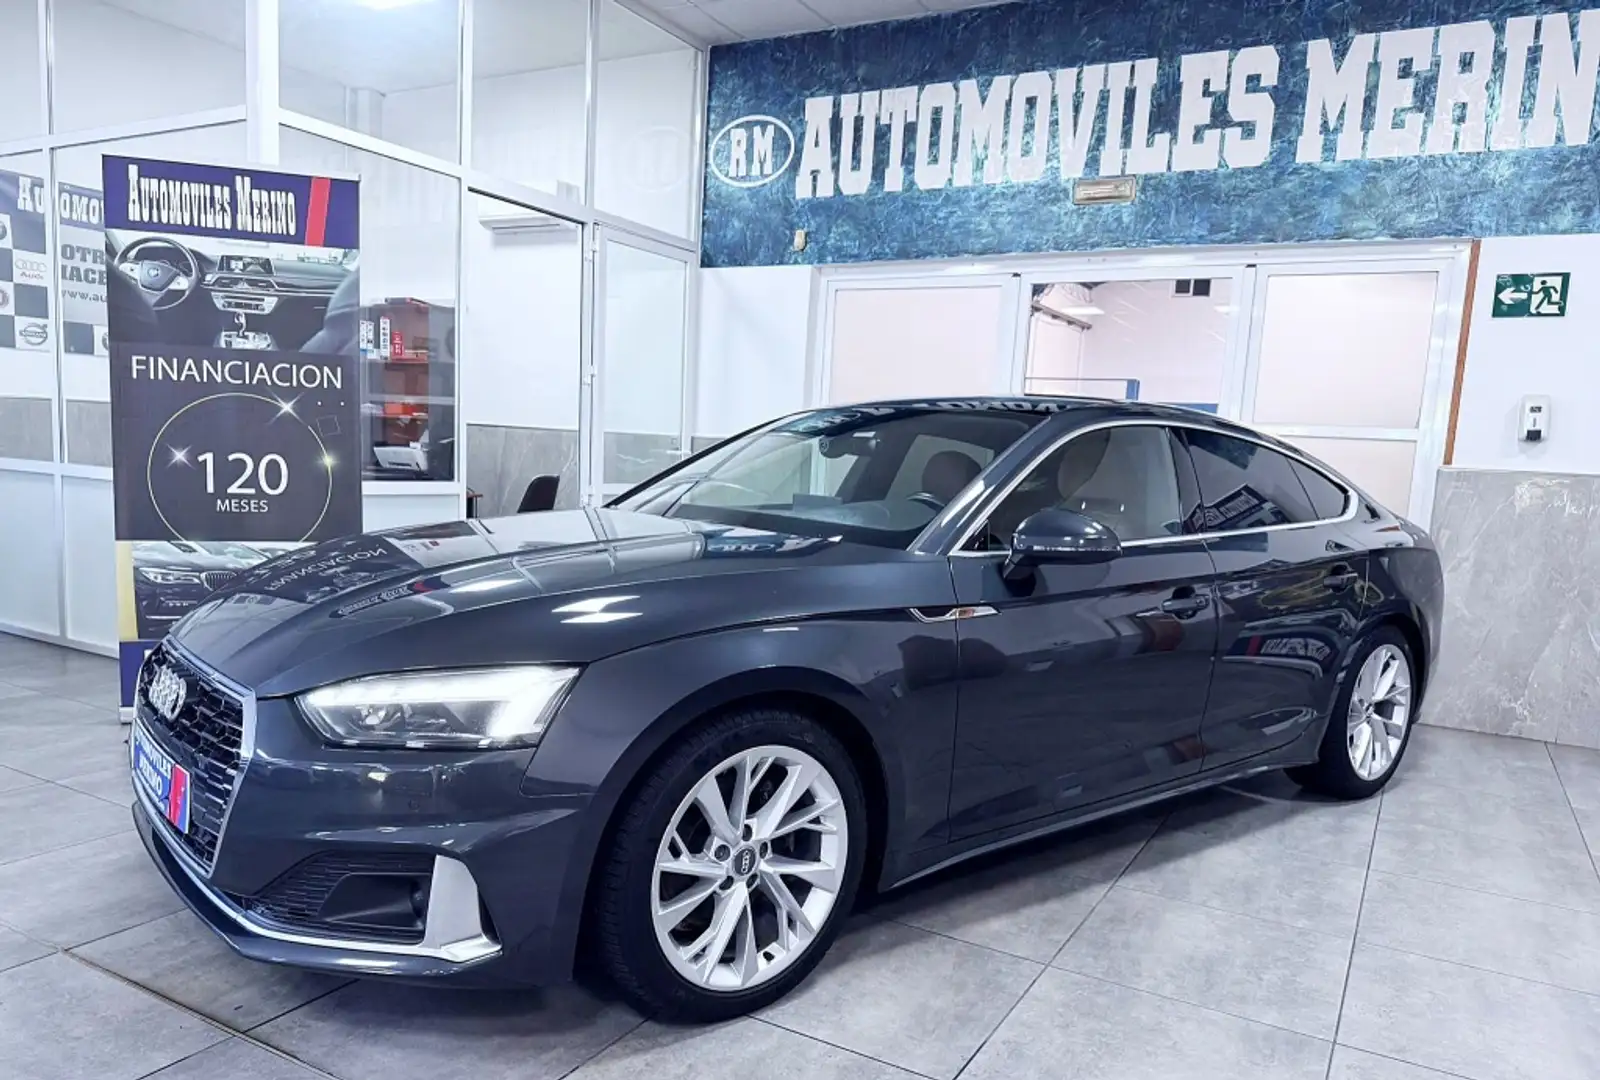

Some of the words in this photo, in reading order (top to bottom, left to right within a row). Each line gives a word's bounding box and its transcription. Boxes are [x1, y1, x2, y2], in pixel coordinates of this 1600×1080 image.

[796, 45, 1281, 200] AUTOMOVILES
[1295, 10, 1600, 163] MERIN
[728, 125, 774, 178] RM
[128, 164, 232, 230] AUTOMOVILES
[235, 175, 297, 236] MERINO
[131, 355, 343, 389] FINANCIACION
[197, 451, 288, 496] 120
[216, 498, 269, 513] MESES
